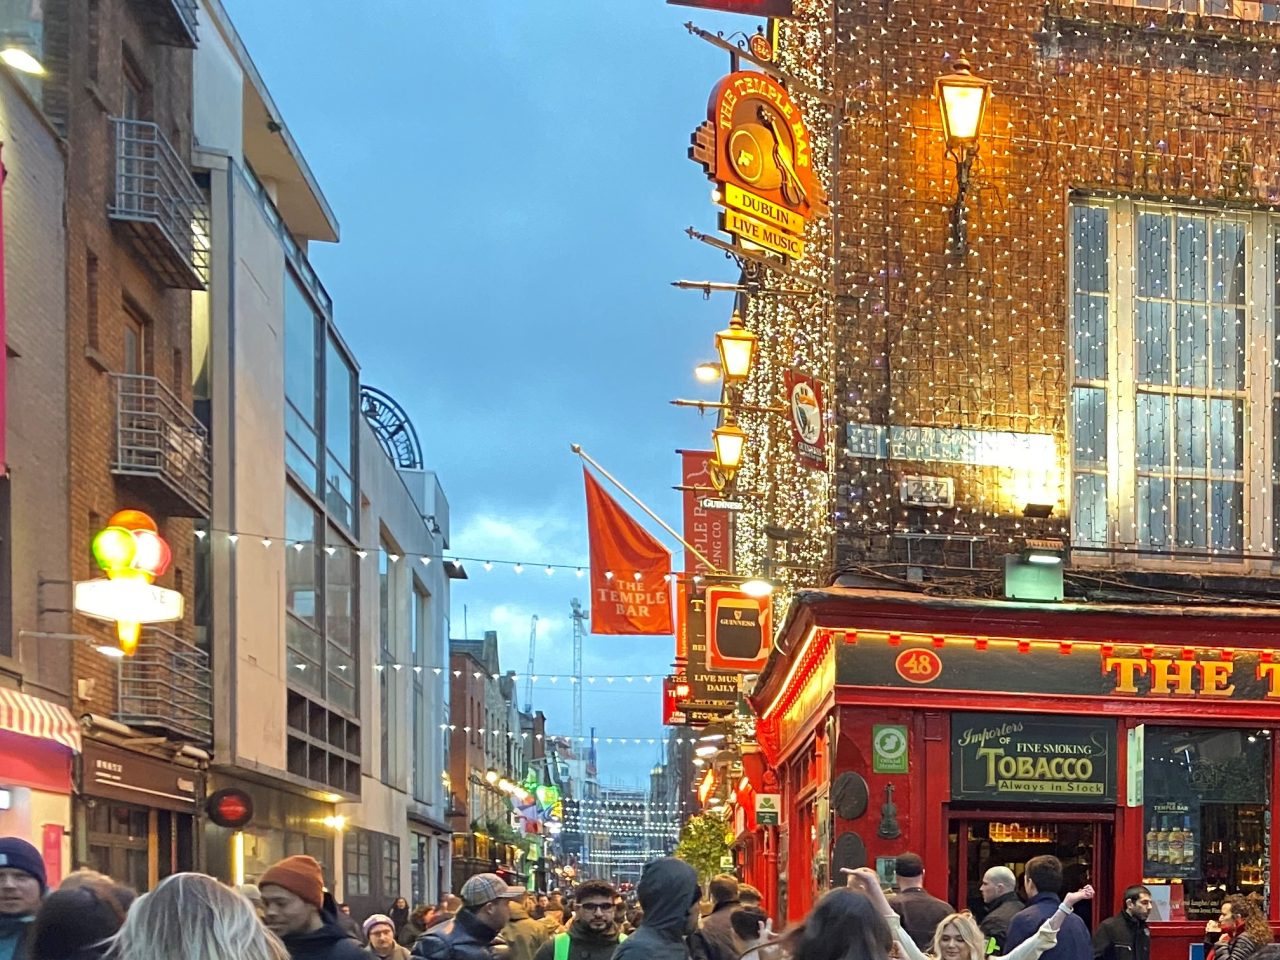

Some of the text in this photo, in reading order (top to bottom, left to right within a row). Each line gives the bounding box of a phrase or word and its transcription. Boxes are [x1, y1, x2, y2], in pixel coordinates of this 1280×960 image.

[719, 76, 808, 168] THE TEMPLE BAR
[742, 194, 789, 226] DUBLIN
[733, 216, 798, 254] LIVE MUSIC
[704, 499, 743, 511] GUINNESS
[618, 580, 645, 592] THE
[598, 588, 667, 605] TEMPLE
[616, 603, 650, 618] BAR
[720, 618, 756, 627] GUINNESS
[904, 653, 932, 675] 48
[694, 674, 738, 684] LIVE MUS
[1106, 657, 1235, 696] THE
[707, 684, 735, 692] DAILY
[958, 722, 1024, 747] Importers
[999, 737, 1011, 745] OF
[1017, 743, 1092, 755] FINE SMOKING
[976, 748, 1093, 786] TOBACCO
[1000, 782, 1102, 793] Always in Stock
